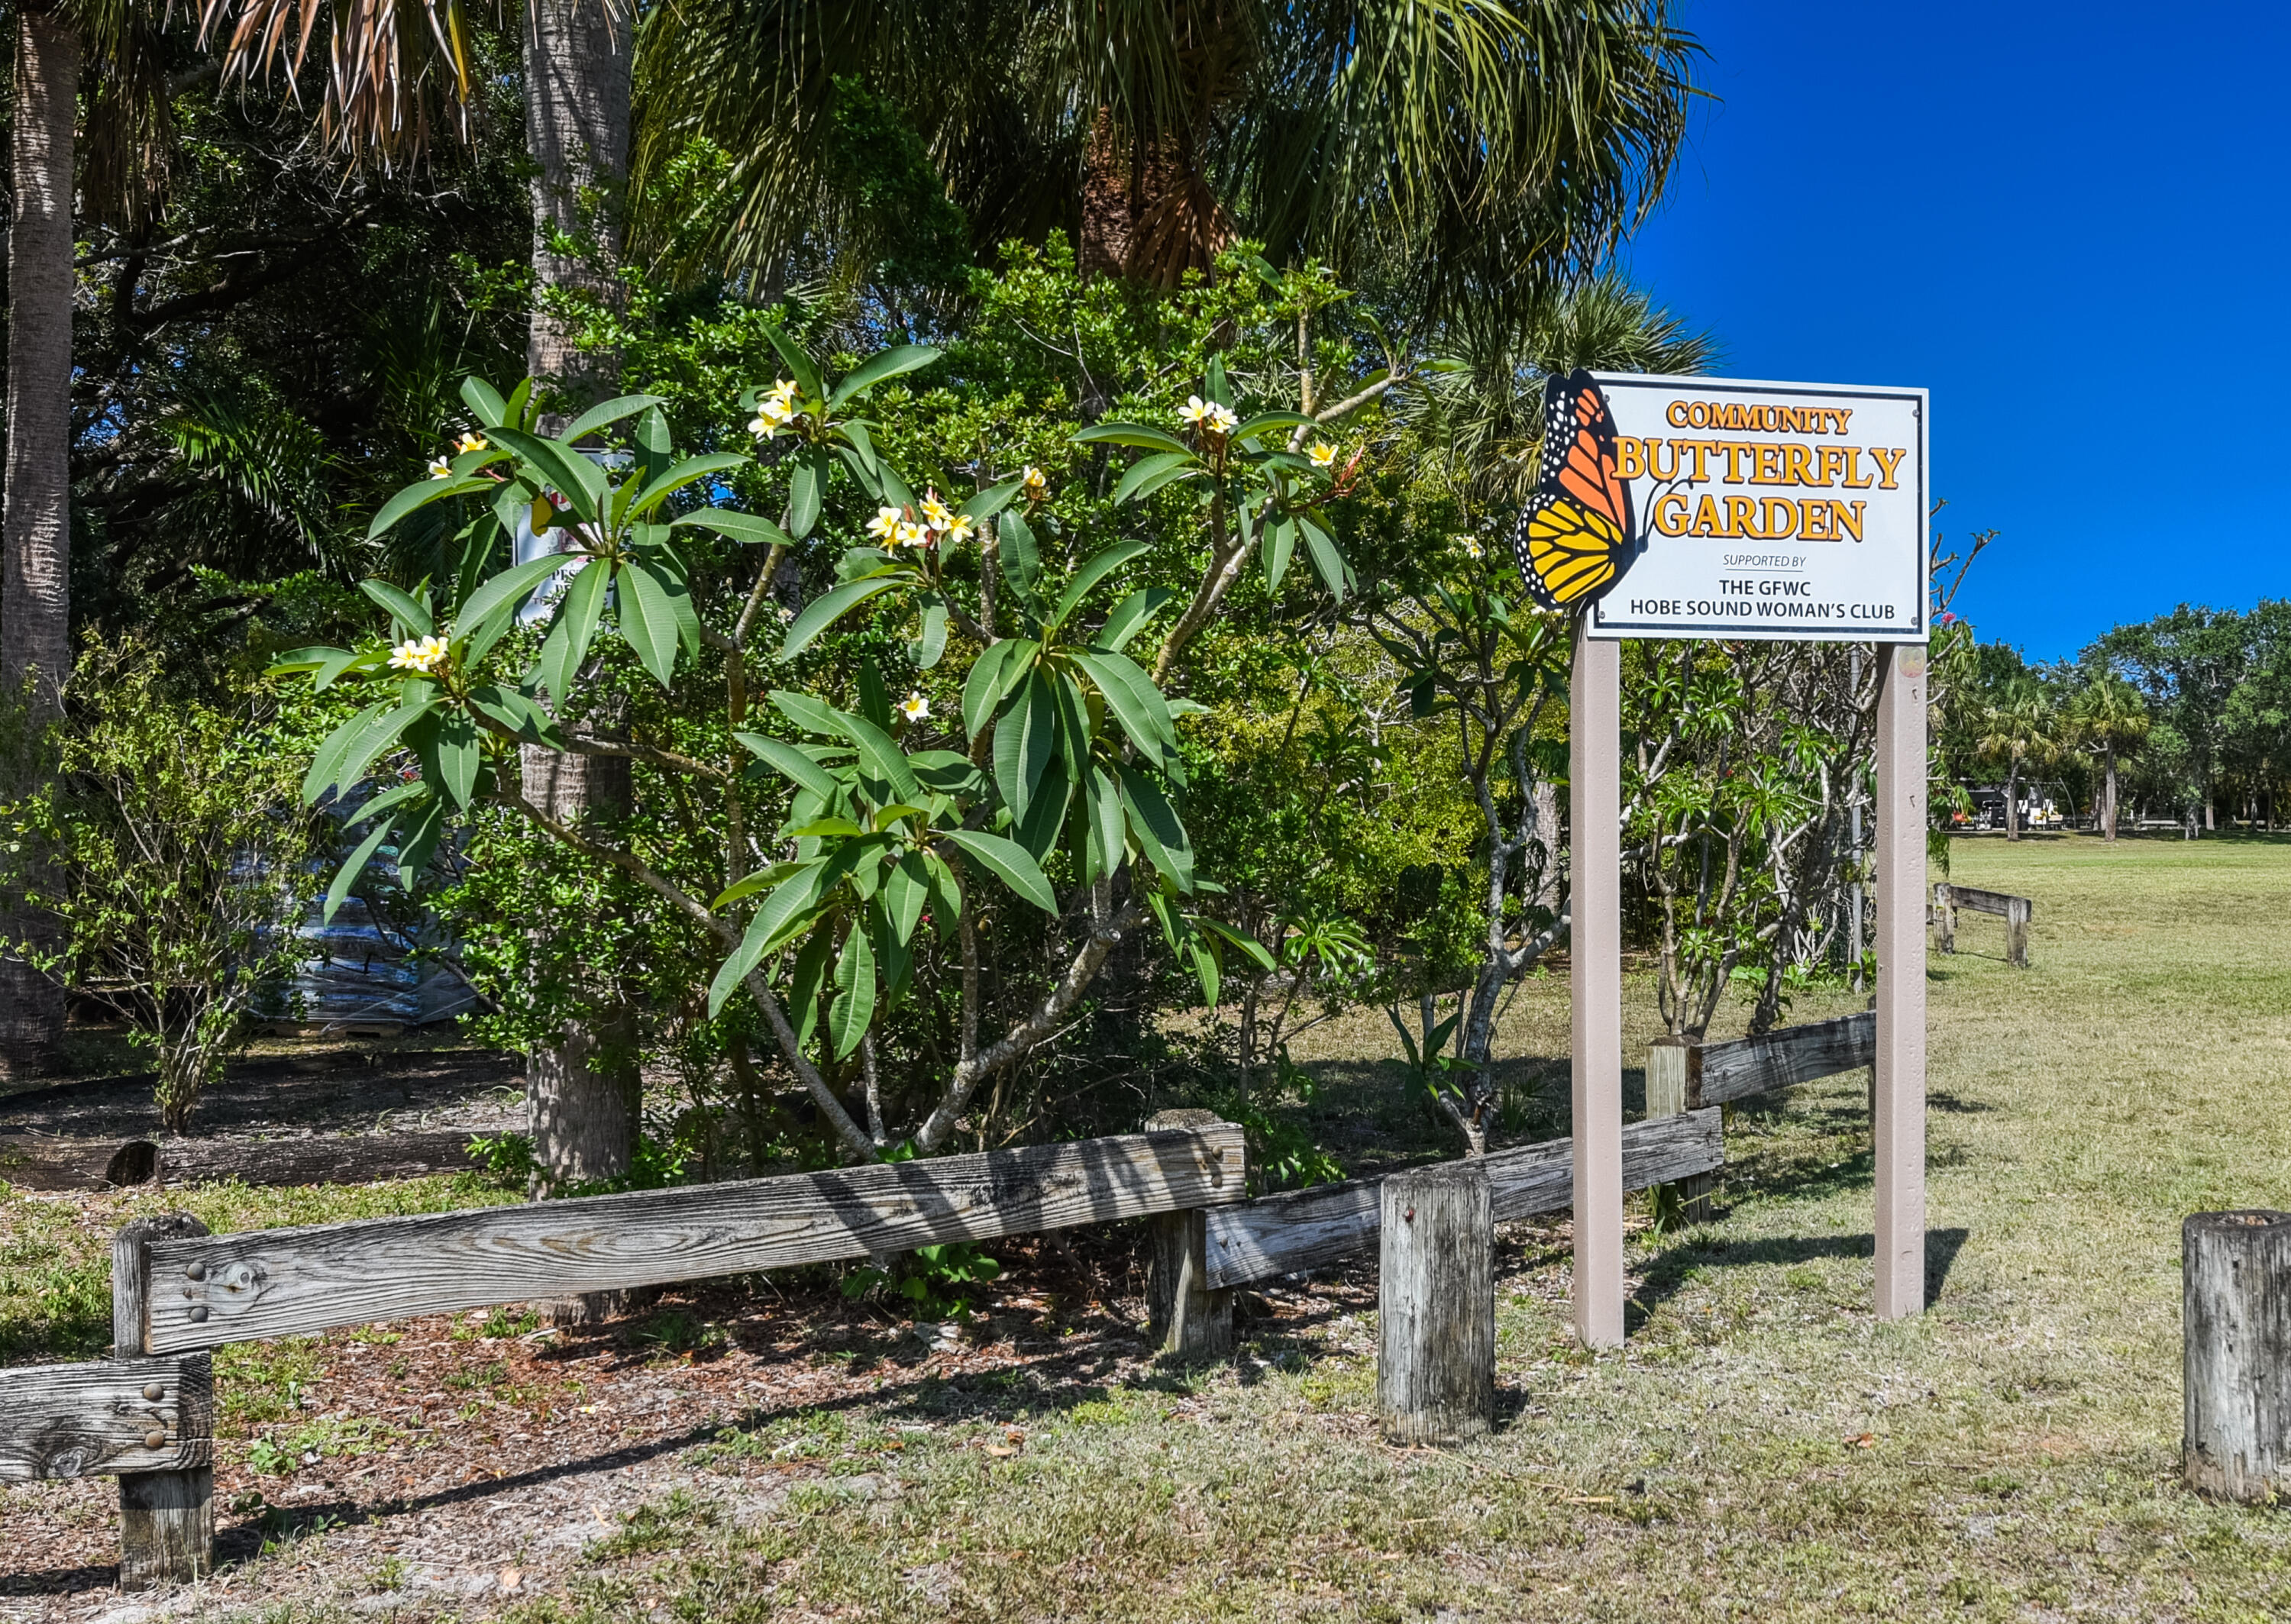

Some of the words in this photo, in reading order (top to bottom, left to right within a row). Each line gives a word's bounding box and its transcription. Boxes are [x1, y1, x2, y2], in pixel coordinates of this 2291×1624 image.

[1666, 400, 1853, 435] COMMUNITY
[1609, 436, 1907, 490] BUTTERFLY
[1653, 492, 1867, 543] GARDEN
[1723, 554, 1789, 567] SUPPORTED
[1792, 556, 1807, 567] BY
[1718, 580, 1754, 596] THE
[1759, 580, 1811, 596] GFWC
[1630, 599, 1682, 615] HOBE
[1686, 600, 1753, 616] SOUND
[1756, 602, 1845, 618] WOMAN'S
[1850, 604, 1895, 619] CLUB
